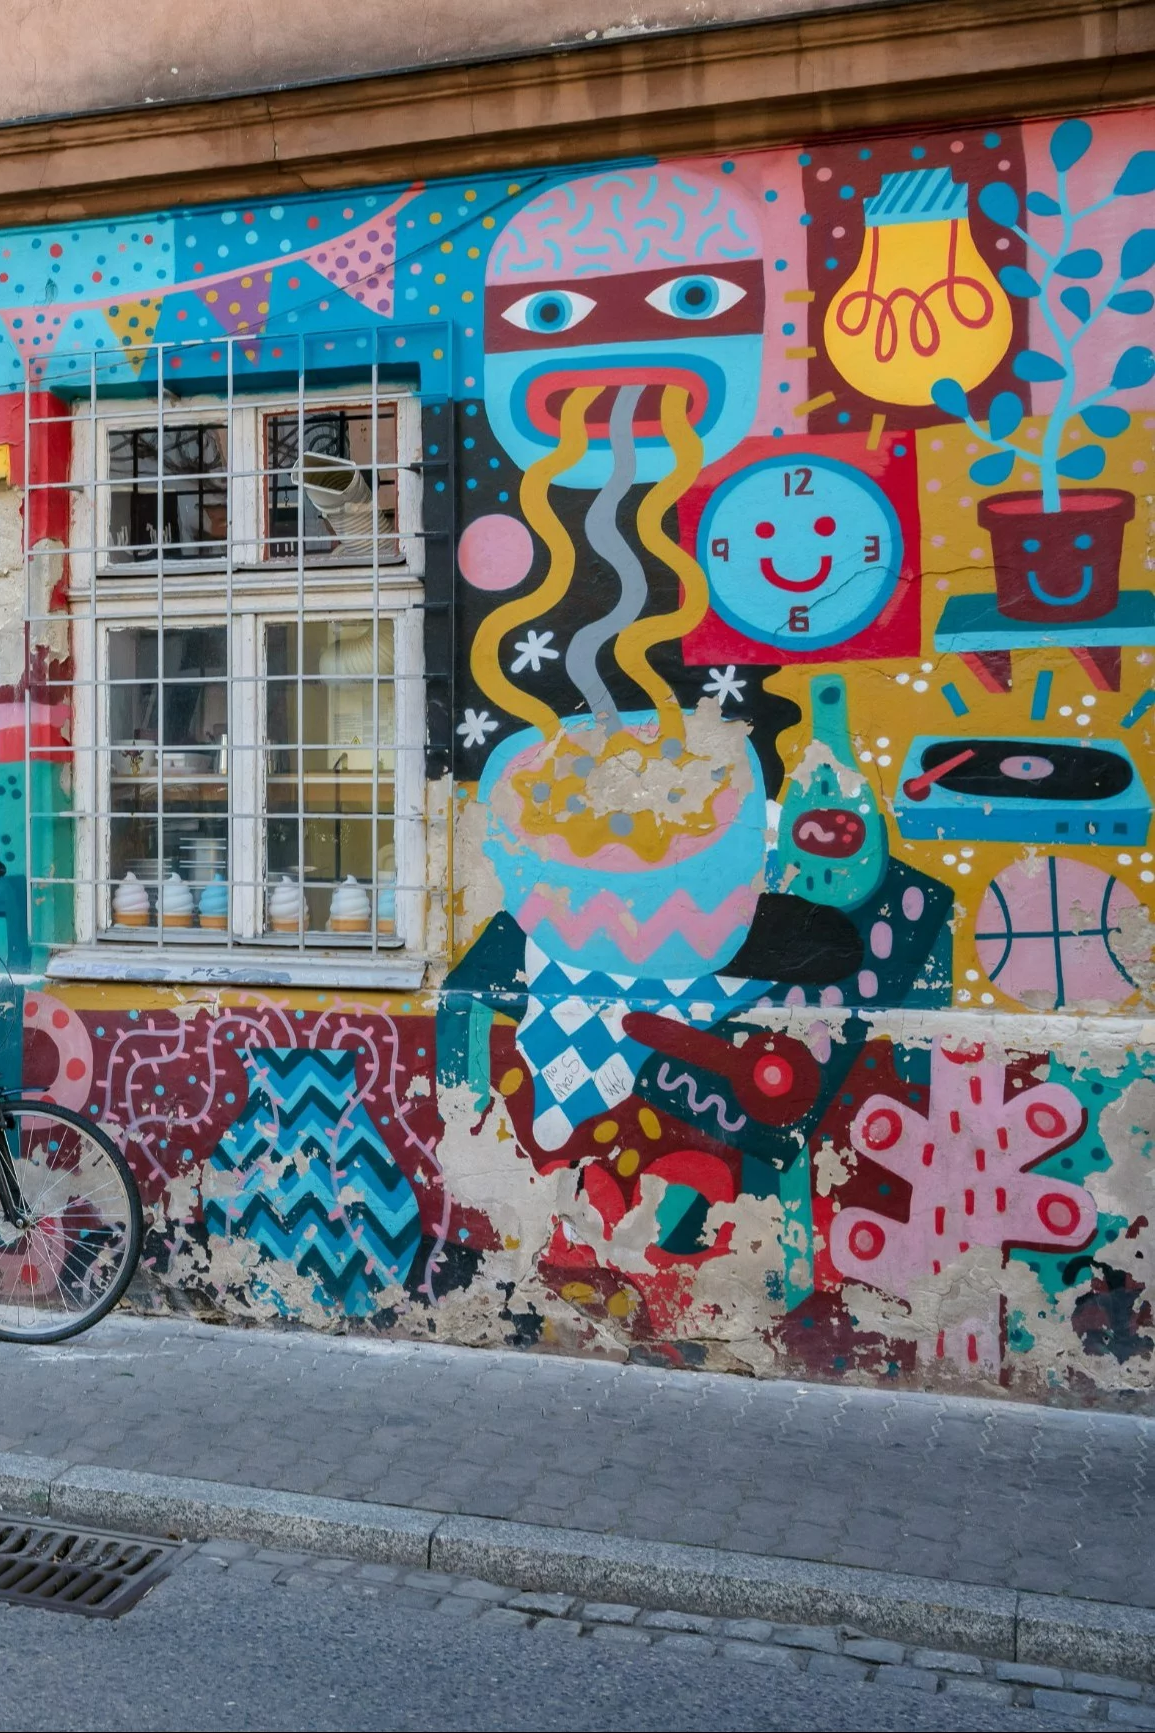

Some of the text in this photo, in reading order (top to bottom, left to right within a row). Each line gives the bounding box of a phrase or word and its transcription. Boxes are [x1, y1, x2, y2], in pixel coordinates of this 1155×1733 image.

[783, 467, 815, 497] 12
[711, 538, 730, 562] 9
[862, 535, 881, 563] 3
[788, 605, 810, 632] 6
